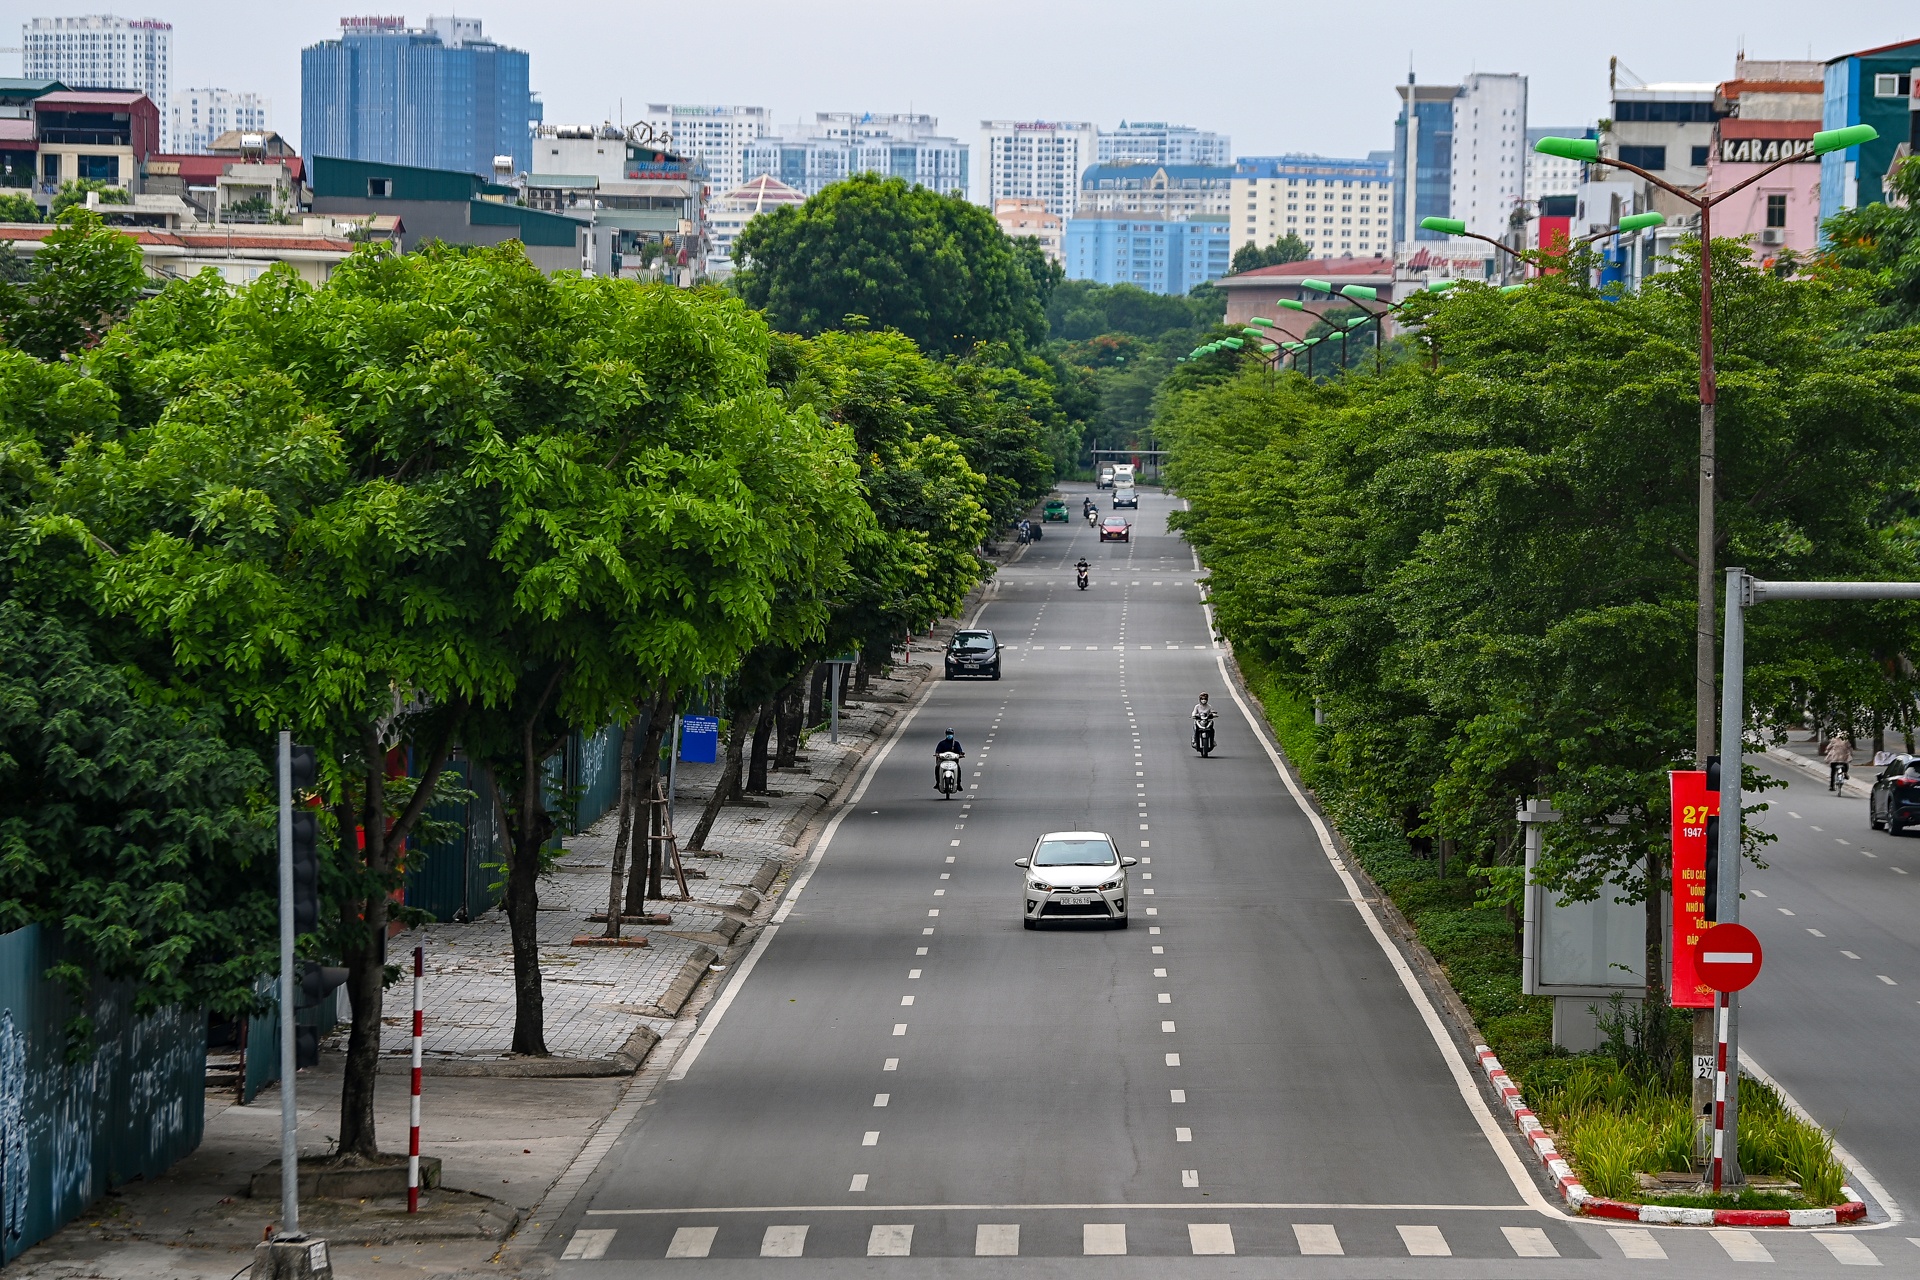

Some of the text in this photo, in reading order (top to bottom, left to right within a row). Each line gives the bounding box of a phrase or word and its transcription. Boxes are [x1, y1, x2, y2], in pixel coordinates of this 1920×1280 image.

[660, 162, 679, 172] Spa
[629, 171, 687, 179] MASSAGE
[1682, 867, 1695, 880] NÊU
[1686, 901, 1699, 913] NHỚ
[1687, 933, 1699, 946] ĐÁP
[1698, 1067, 1713, 1079] 27
